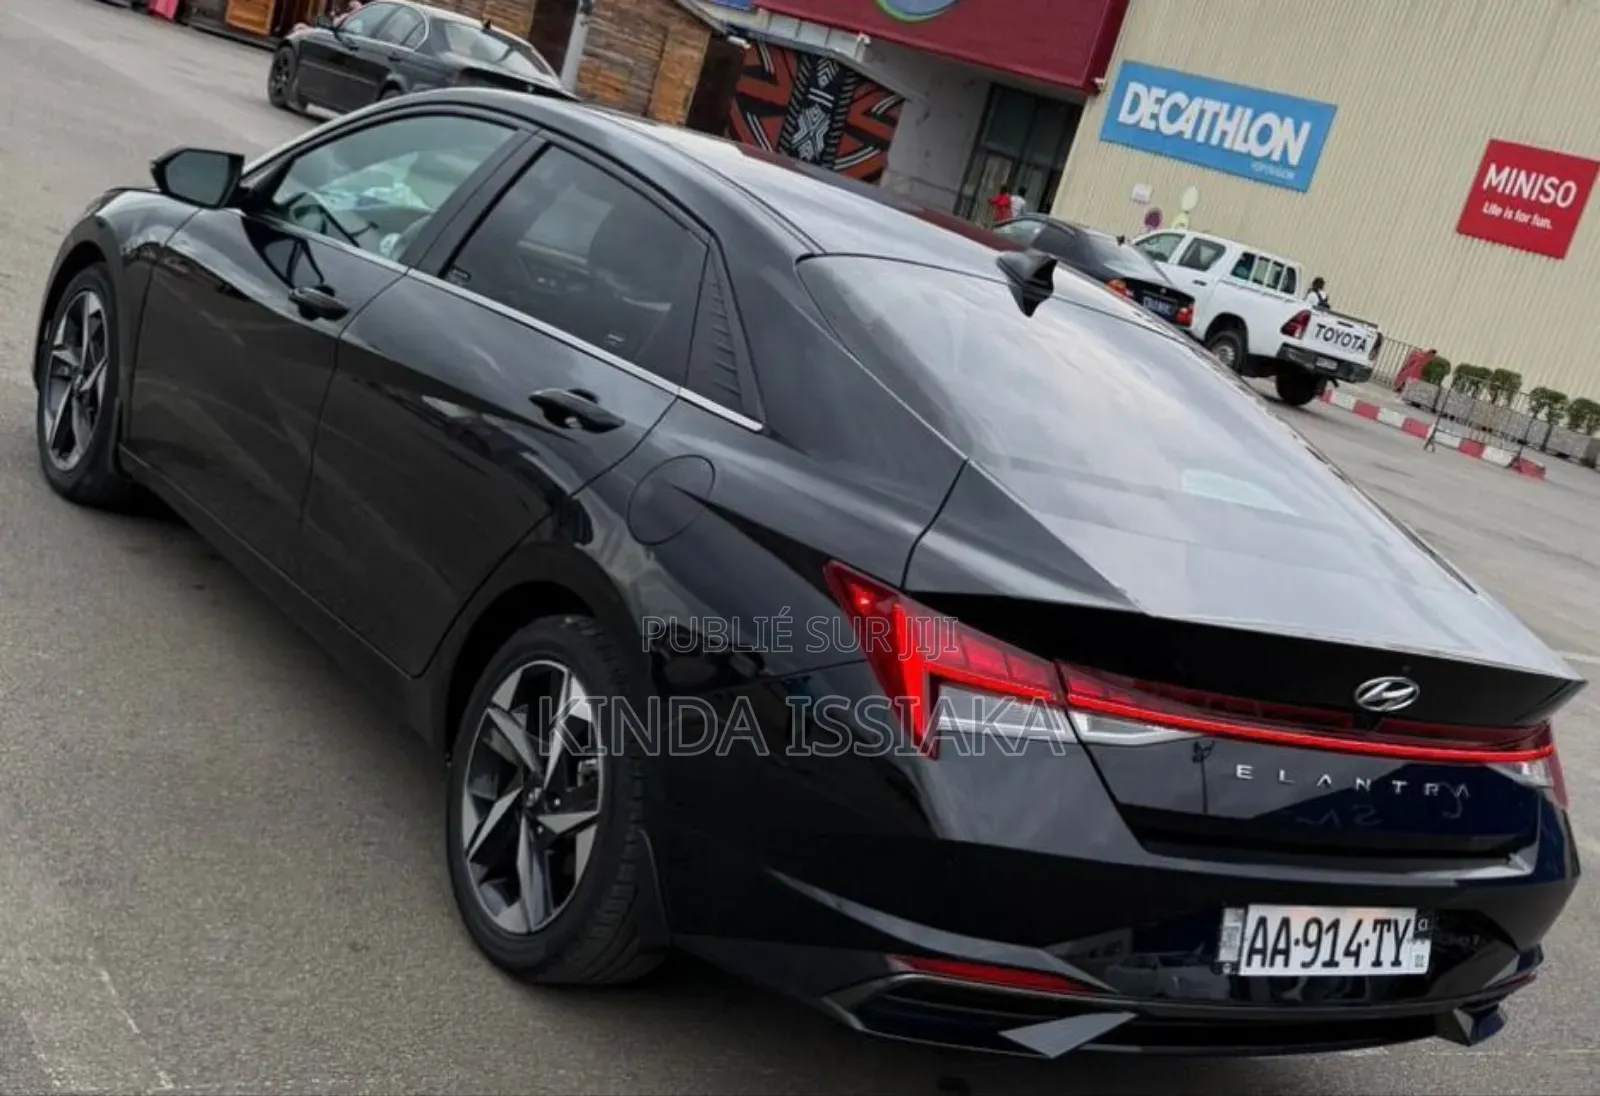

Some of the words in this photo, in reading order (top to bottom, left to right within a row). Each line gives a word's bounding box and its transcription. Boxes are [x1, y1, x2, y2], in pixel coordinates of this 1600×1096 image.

[1117, 82, 1311, 166] DECATHLON
[1482, 162, 1577, 208] MINISO
[1503, 205, 1514, 220] is
[1314, 323, 1369, 352] TOYOTA
[1235, 763, 1471, 799] ELANTRA
